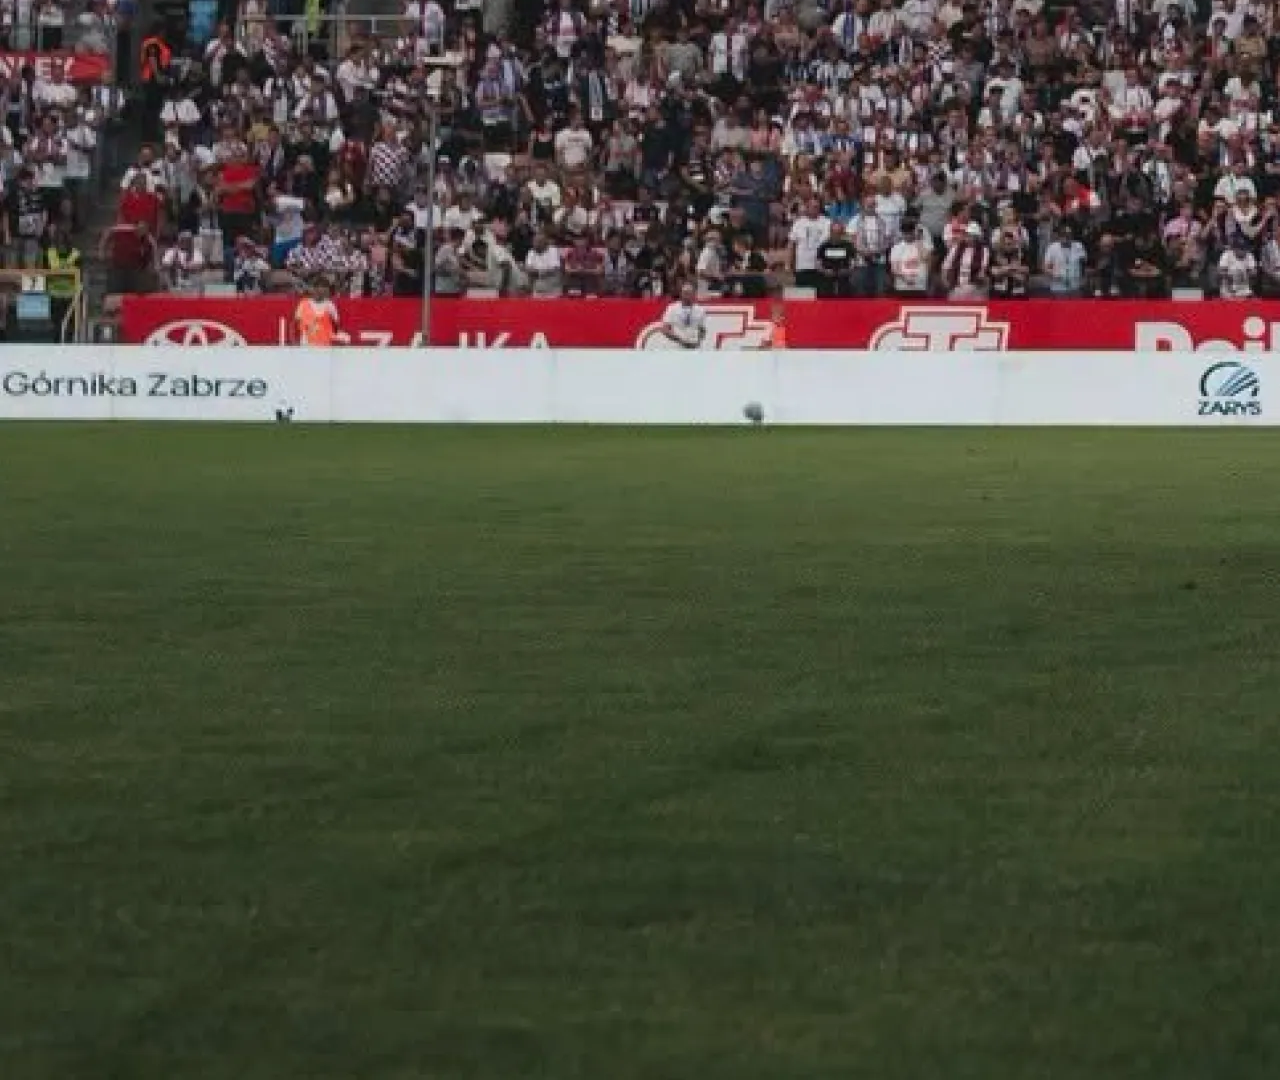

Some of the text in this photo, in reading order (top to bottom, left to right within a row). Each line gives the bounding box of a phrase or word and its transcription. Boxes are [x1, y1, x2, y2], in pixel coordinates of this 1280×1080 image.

[2, 369, 268, 398] Górnika Zabrze
[1197, 399, 1262, 416] ZARYS
